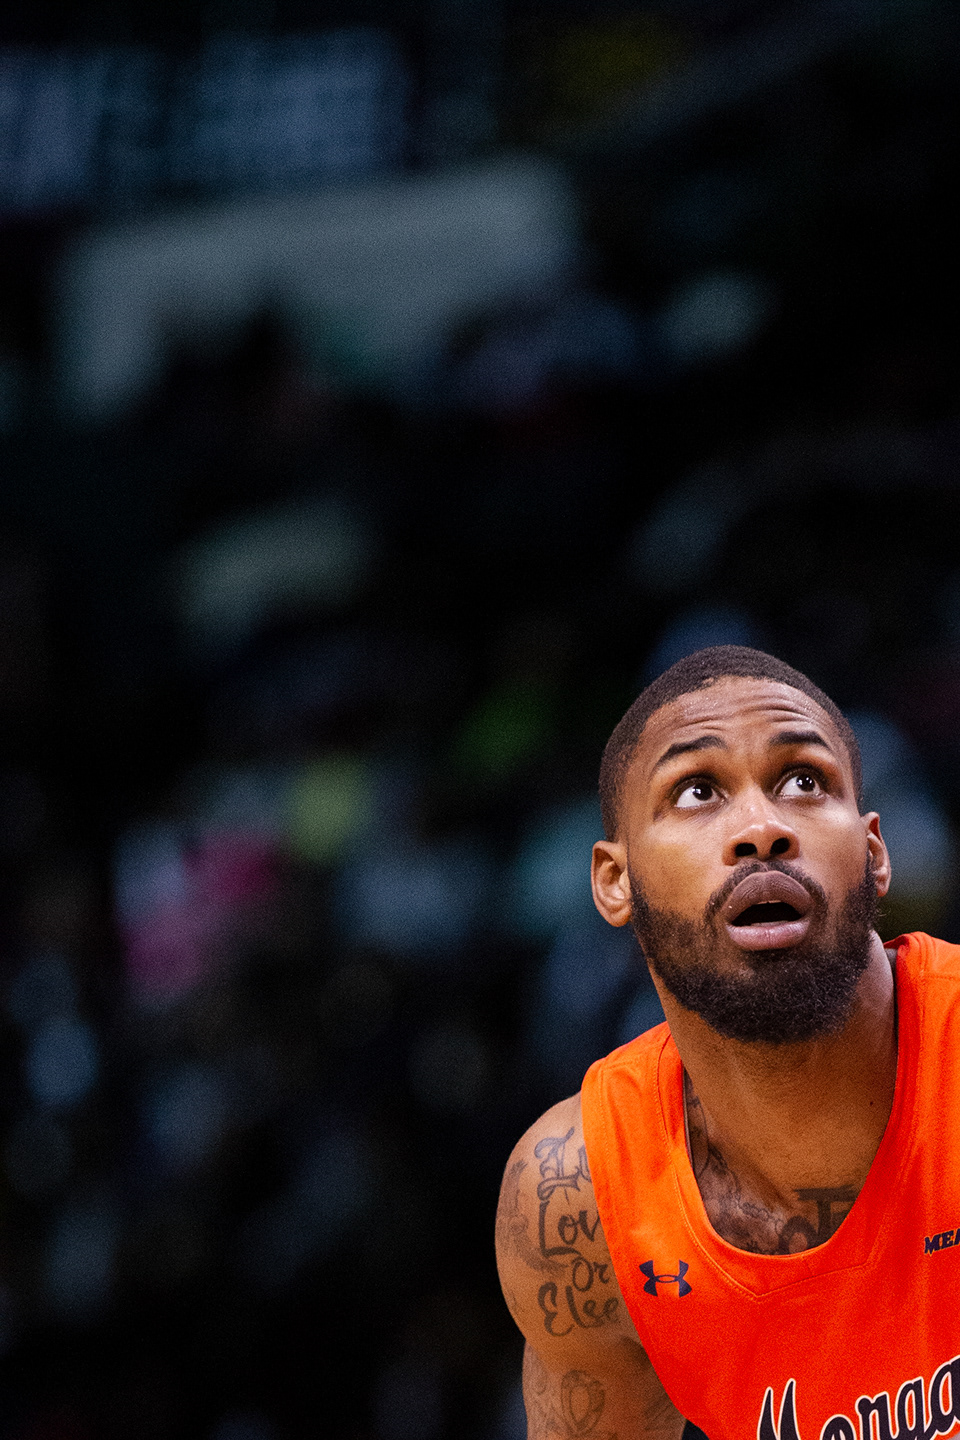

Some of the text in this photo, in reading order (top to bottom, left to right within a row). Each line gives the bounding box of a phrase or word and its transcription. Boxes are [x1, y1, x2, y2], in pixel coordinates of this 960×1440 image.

[538, 1200, 603, 1259] Lov
[570, 1256, 610, 1292] Or
[537, 1280, 620, 1338] Else
